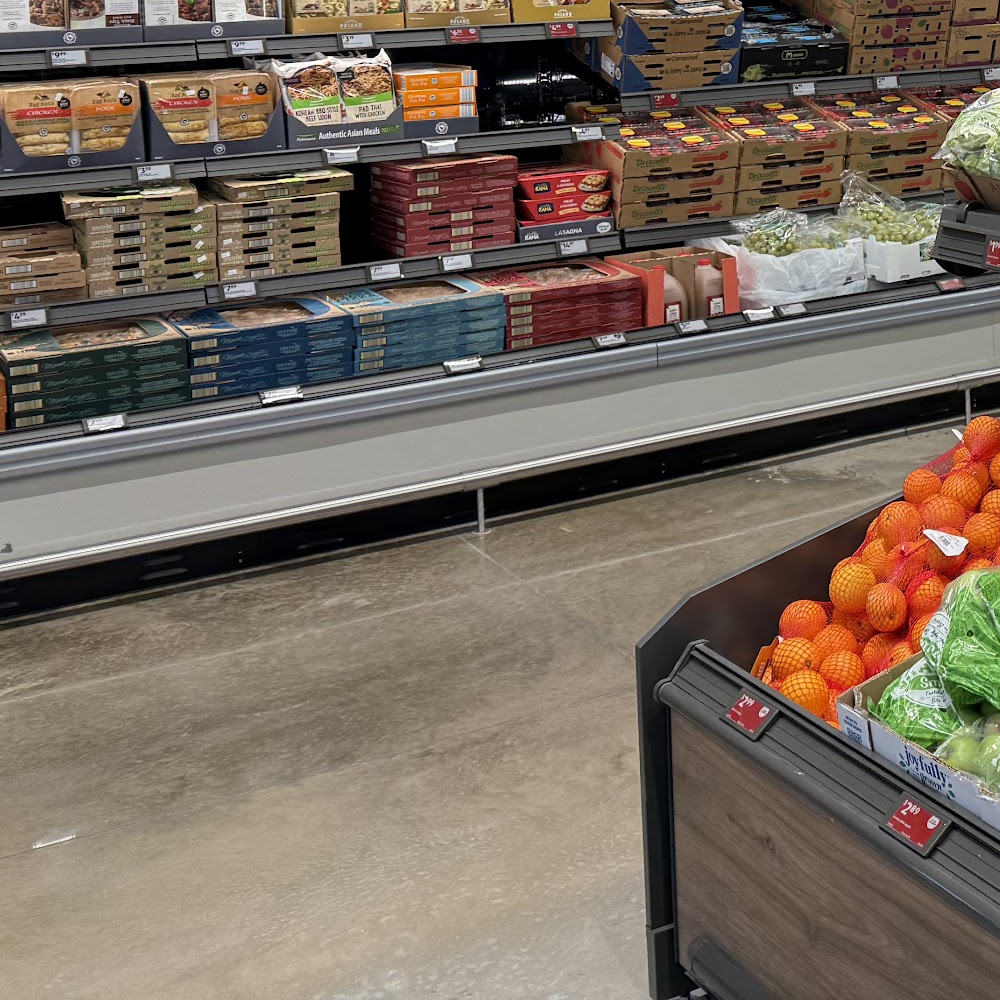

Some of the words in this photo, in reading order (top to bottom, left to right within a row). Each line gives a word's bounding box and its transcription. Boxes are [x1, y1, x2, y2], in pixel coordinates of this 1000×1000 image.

[318, 131, 346, 140] Authentic
[347, 130, 363, 138] Asian
[363, 126, 380, 136] Meals
[636, 157, 671, 168] Driscoll's
[633, 183, 668, 193] Driscoll's
[554, 227, 583, 237] LASAGNA
